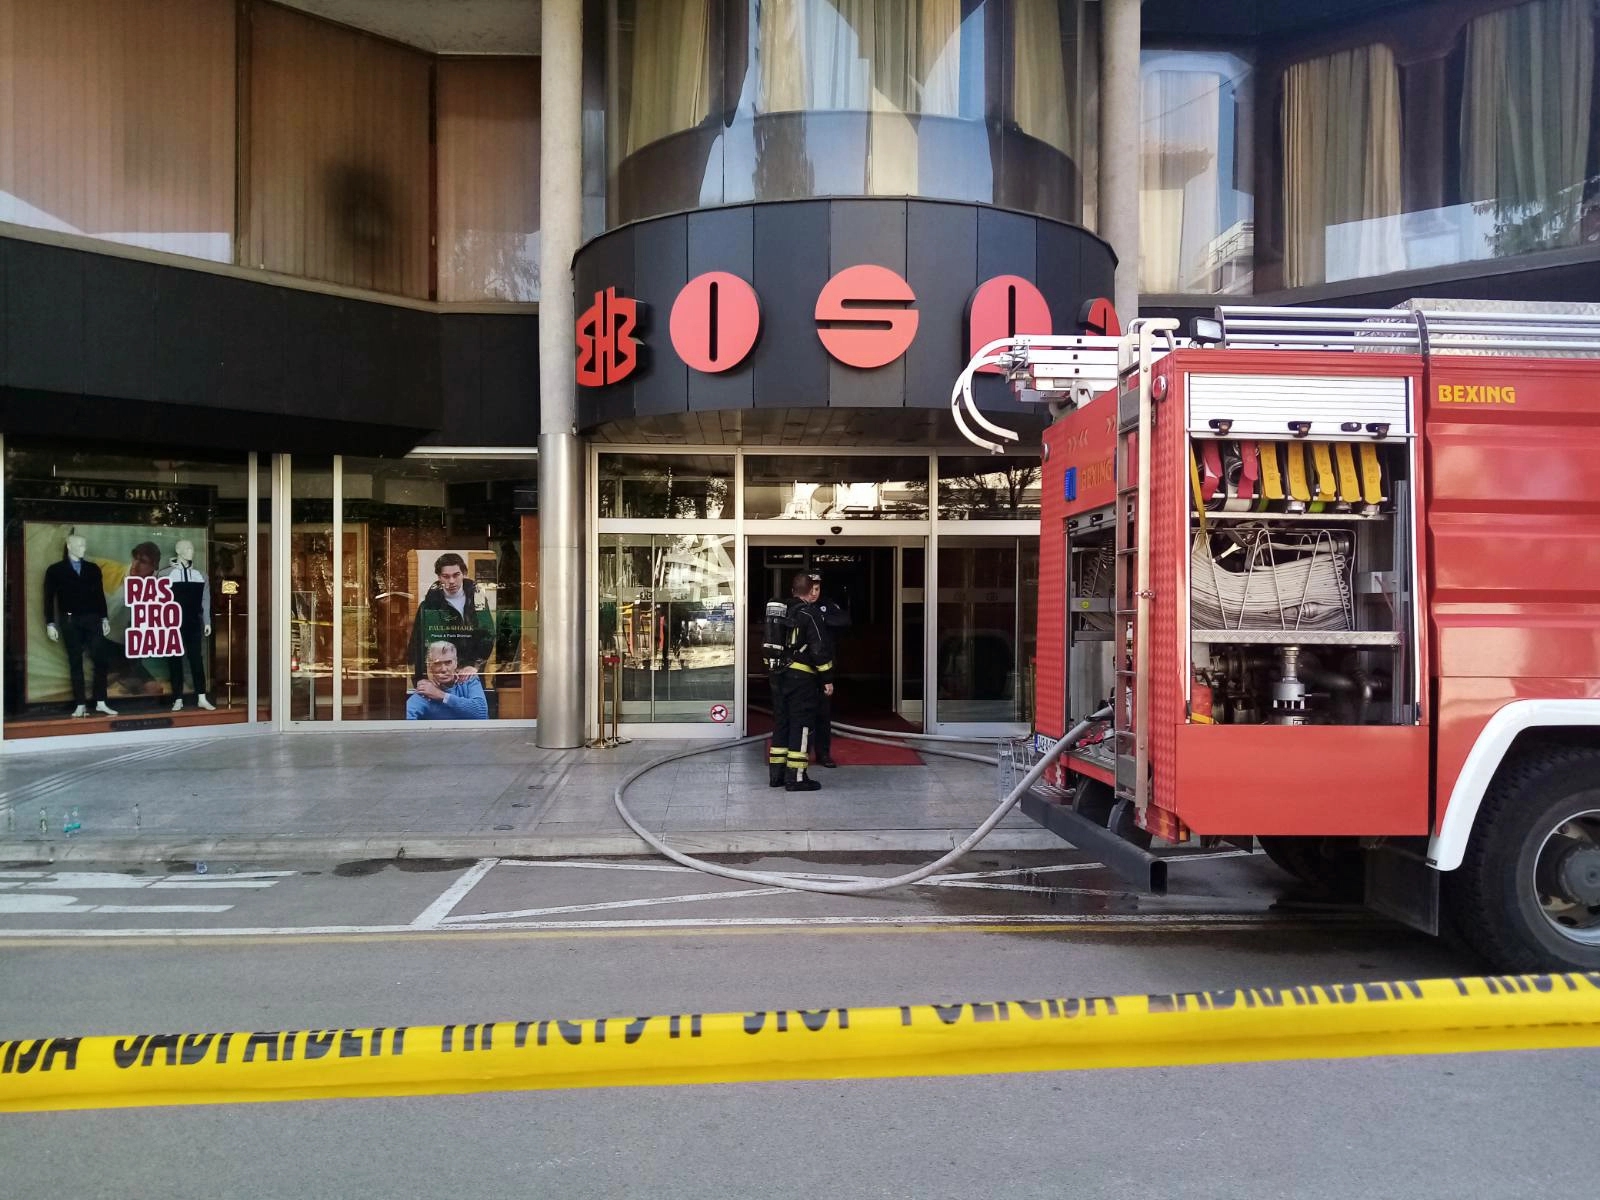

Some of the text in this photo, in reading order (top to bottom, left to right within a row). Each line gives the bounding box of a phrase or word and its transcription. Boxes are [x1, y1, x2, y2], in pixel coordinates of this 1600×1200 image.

[1438, 384, 1516, 404] BEXING
[59, 484, 99, 498] PAUL
[127, 578, 172, 604] RAS
[134, 604, 180, 628] PRO
[127, 628, 182, 656] DAJA
